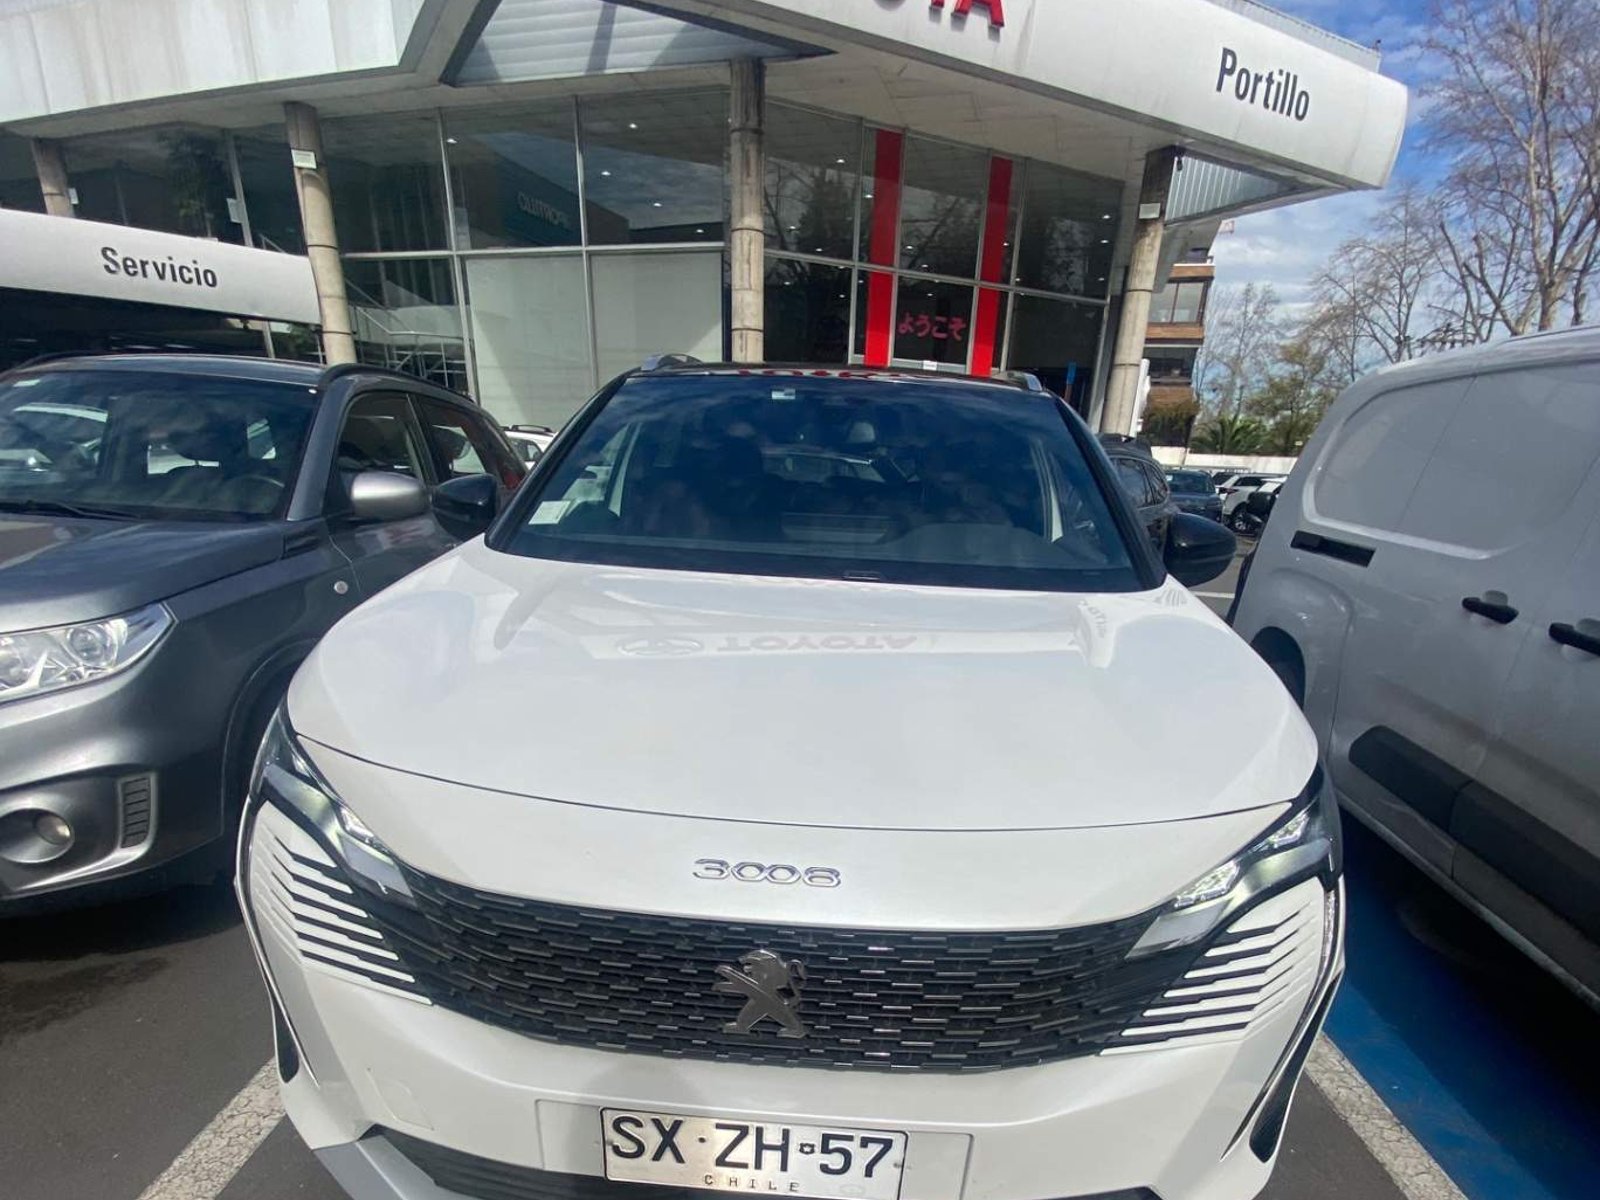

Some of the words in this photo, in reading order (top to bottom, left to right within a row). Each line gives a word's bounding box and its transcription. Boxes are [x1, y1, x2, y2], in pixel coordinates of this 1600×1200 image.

[1216, 47, 1310, 122] Portillo
[101, 246, 218, 288] Servicio
[898, 311, 967, 341] ようこそ
[693, 858, 842, 888] 3008
[704, 1174, 801, 1193] CHILE
